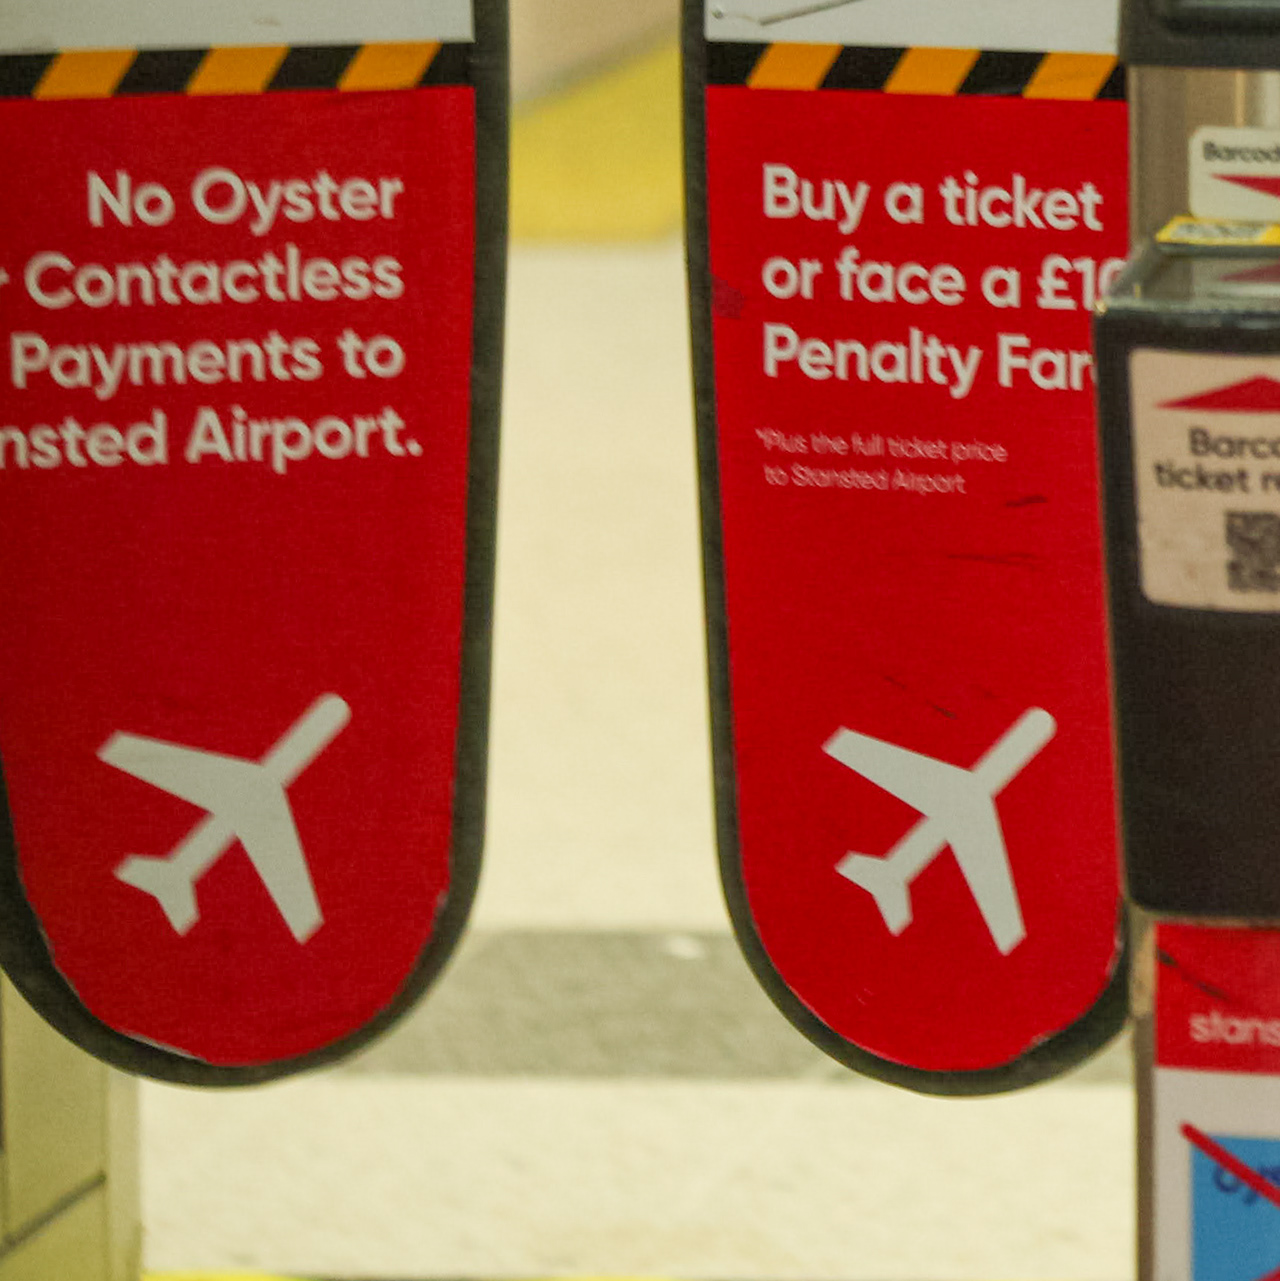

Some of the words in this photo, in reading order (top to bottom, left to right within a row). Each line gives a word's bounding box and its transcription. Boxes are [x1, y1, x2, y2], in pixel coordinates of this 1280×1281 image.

[87, 170, 175, 226] No
[191, 166, 404, 237] Oyster
[762, 162, 870, 235] Buy
[885, 181, 924, 224] a
[939, 169, 1104, 231] ticket
[24, 243, 404, 309] Contactless
[761, 256, 823, 300] or
[835, 245, 967, 306] face
[981, 266, 1021, 308] a
[1036, 253, 1128, 311] £10
[10, 329, 324, 401] Payments
[337, 328, 405, 379] to
[762, 322, 983, 399] Penalty
[997, 332, 1094, 391] Far
[0, 408, 168, 469] nsted
[185, 405, 423, 475] Airport.
[1155, 462, 1253, 494] ticket
